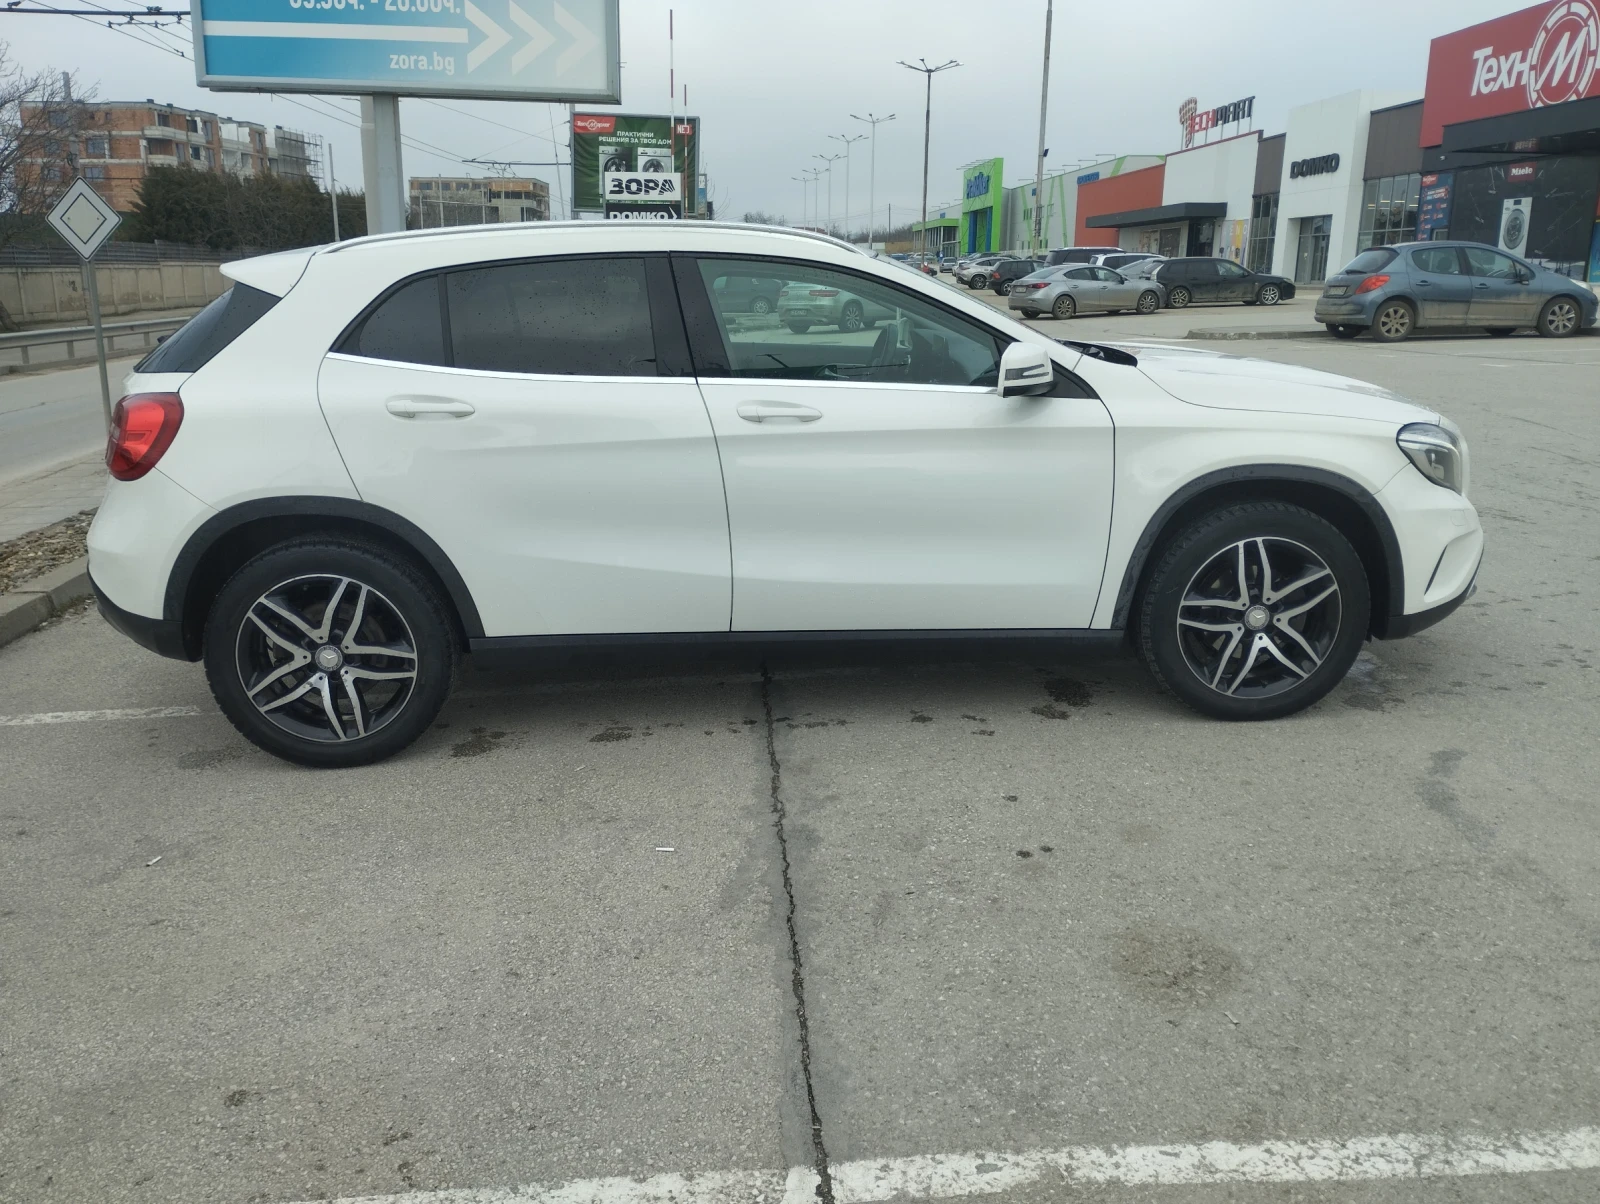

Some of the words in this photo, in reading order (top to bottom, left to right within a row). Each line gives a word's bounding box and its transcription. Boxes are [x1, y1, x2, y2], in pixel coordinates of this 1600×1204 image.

[389, 51, 455, 76] zora.bg
[617, 130, 654, 138] ПРАКТИЧНИ
[1290, 153, 1340, 179] DOMKO
[1511, 166, 1533, 176] Miele
[609, 178, 676, 195] ЗОРА
